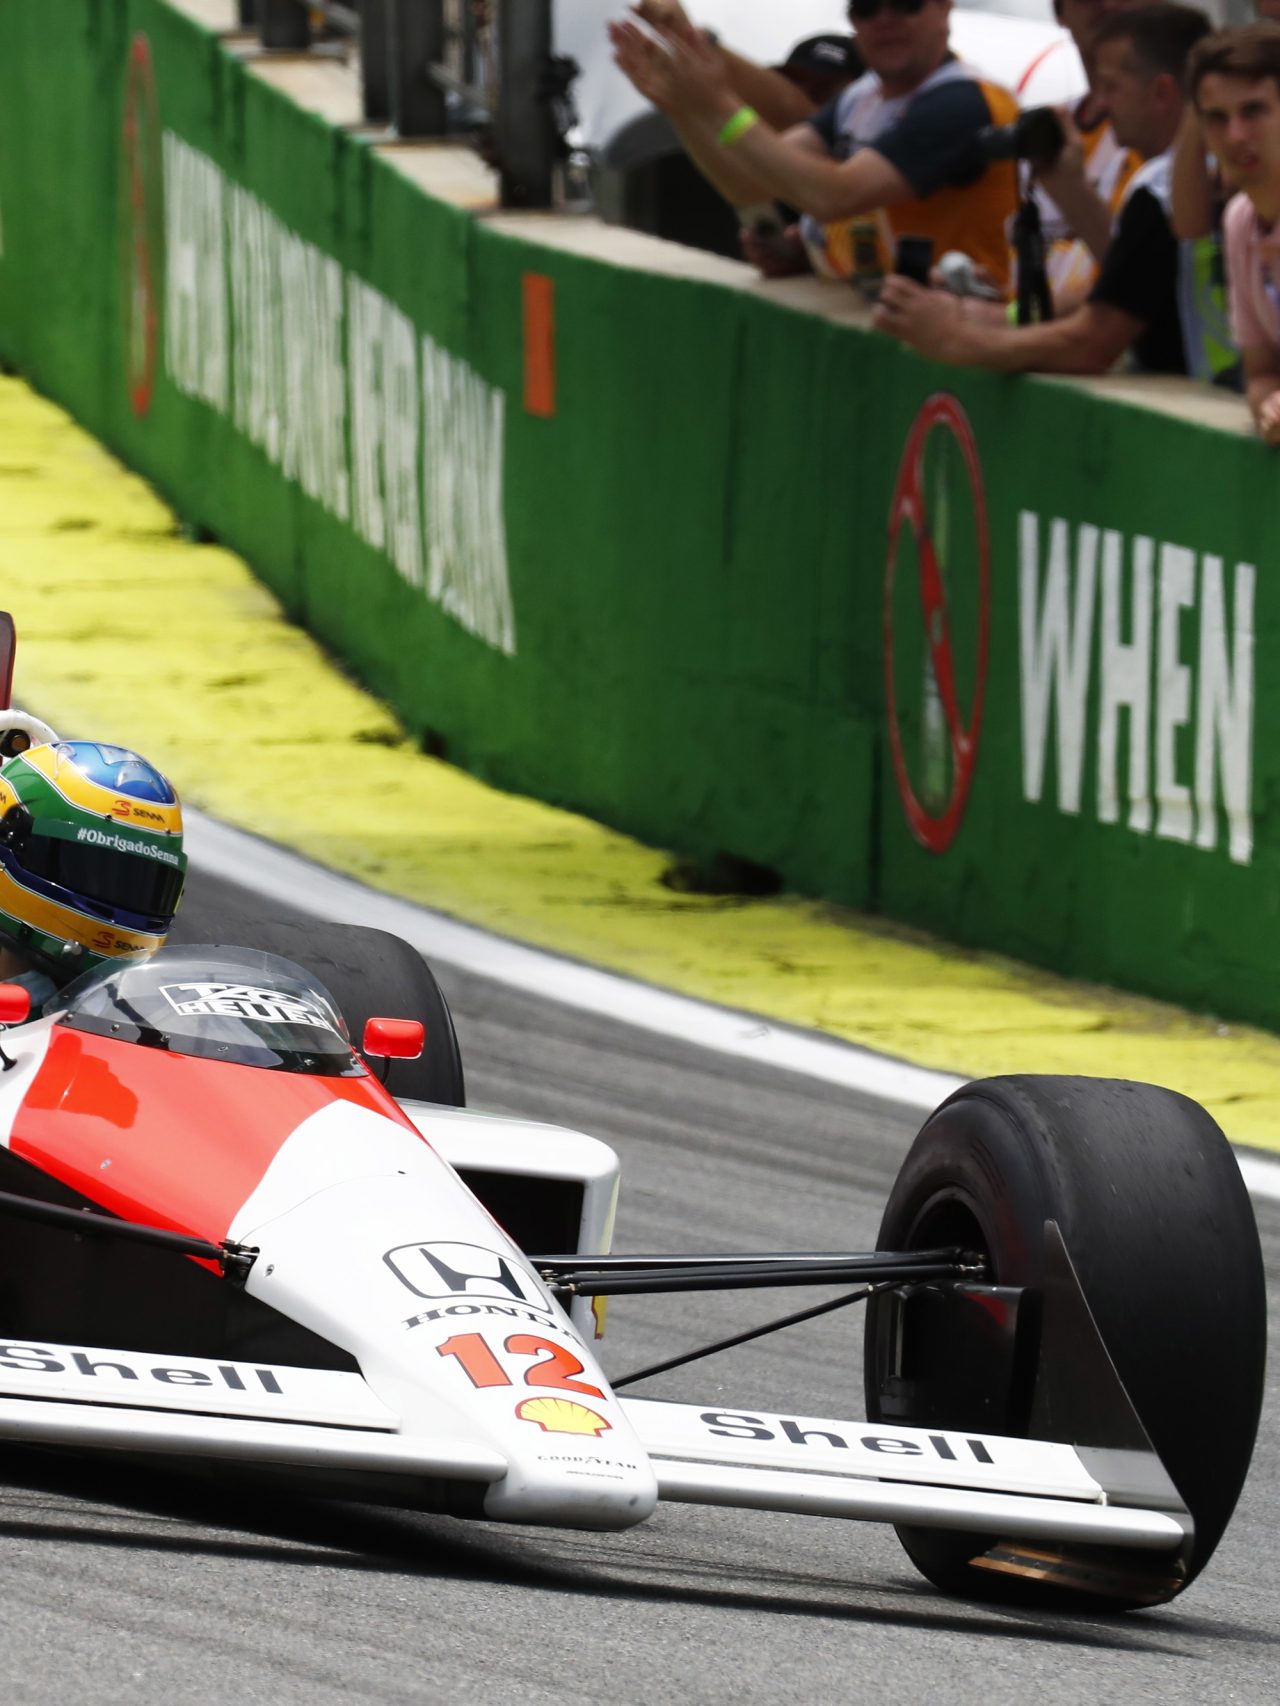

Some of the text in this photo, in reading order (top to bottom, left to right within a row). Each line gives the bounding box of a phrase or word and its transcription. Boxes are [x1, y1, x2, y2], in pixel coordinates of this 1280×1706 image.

[1018, 508, 1257, 867] WHEN
[76, 827, 180, 867] #ObrigadoSenna
[435, 1332, 608, 1401] 12
[699, 1411, 995, 1465] Shell
